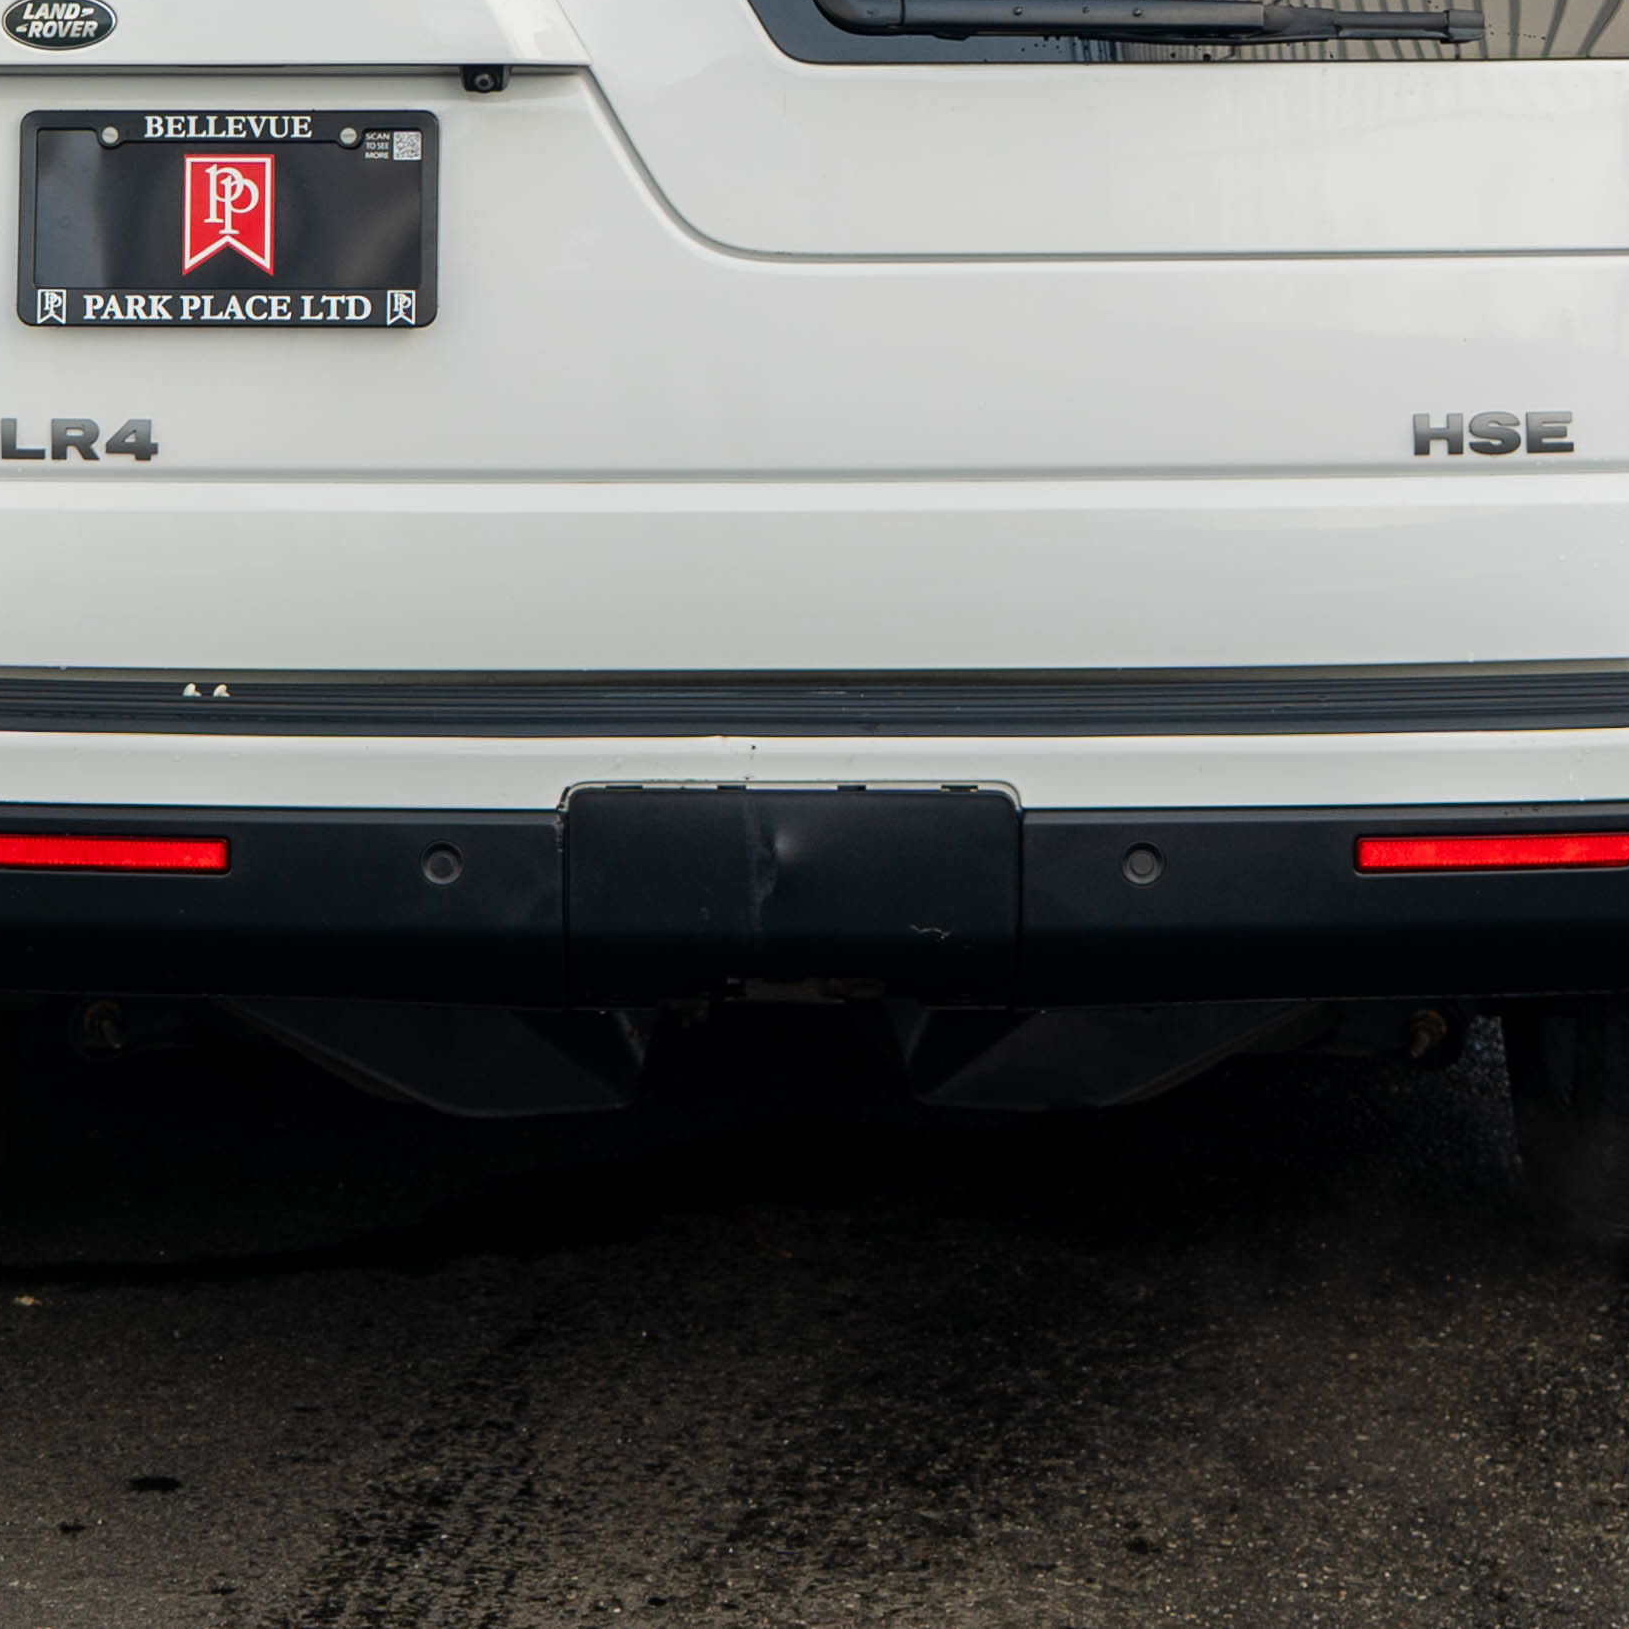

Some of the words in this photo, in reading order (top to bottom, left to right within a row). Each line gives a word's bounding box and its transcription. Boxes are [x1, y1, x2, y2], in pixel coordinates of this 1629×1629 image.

[23, 3, 81, 20] LAND
[27, 20, 98, 38] ROVER
[144, 116, 312, 139] BELLEVUE
[365, 132, 390, 141] SCAN
[365, 152, 390, 160] MORE
[83, 295, 173, 321] PARK
[180, 296, 292, 321] PLACE
[300, 296, 372, 321] LTD
[0, 417, 159, 461] LR4
[1412, 411, 1575, 456] HSE
